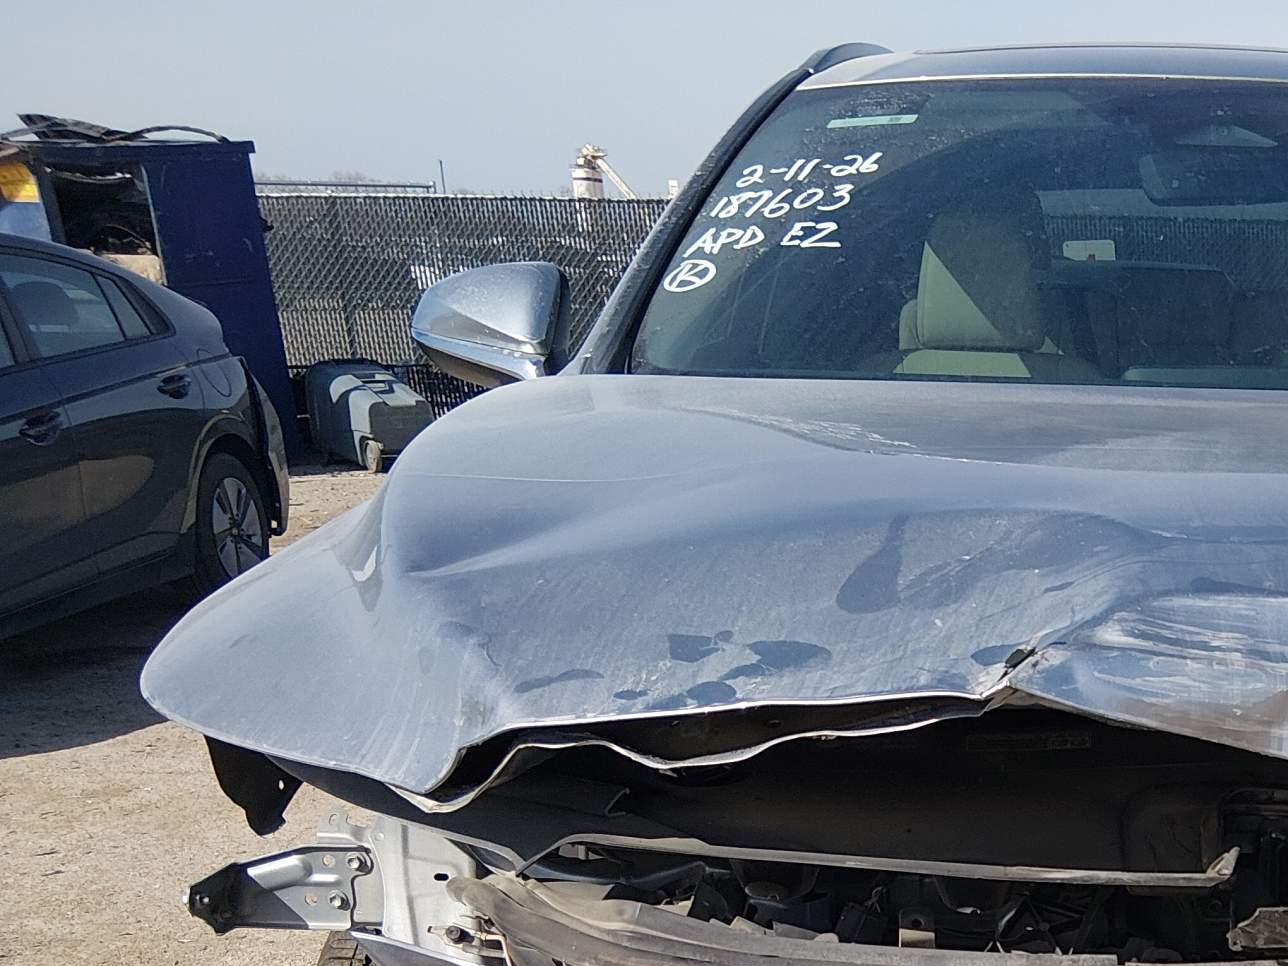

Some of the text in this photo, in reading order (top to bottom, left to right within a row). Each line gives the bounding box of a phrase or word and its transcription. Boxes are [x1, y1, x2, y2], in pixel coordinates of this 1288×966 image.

[735, 152, 883, 188] 2-11-26
[710, 184, 854, 218] 187603
[683, 225, 765, 258] APD
